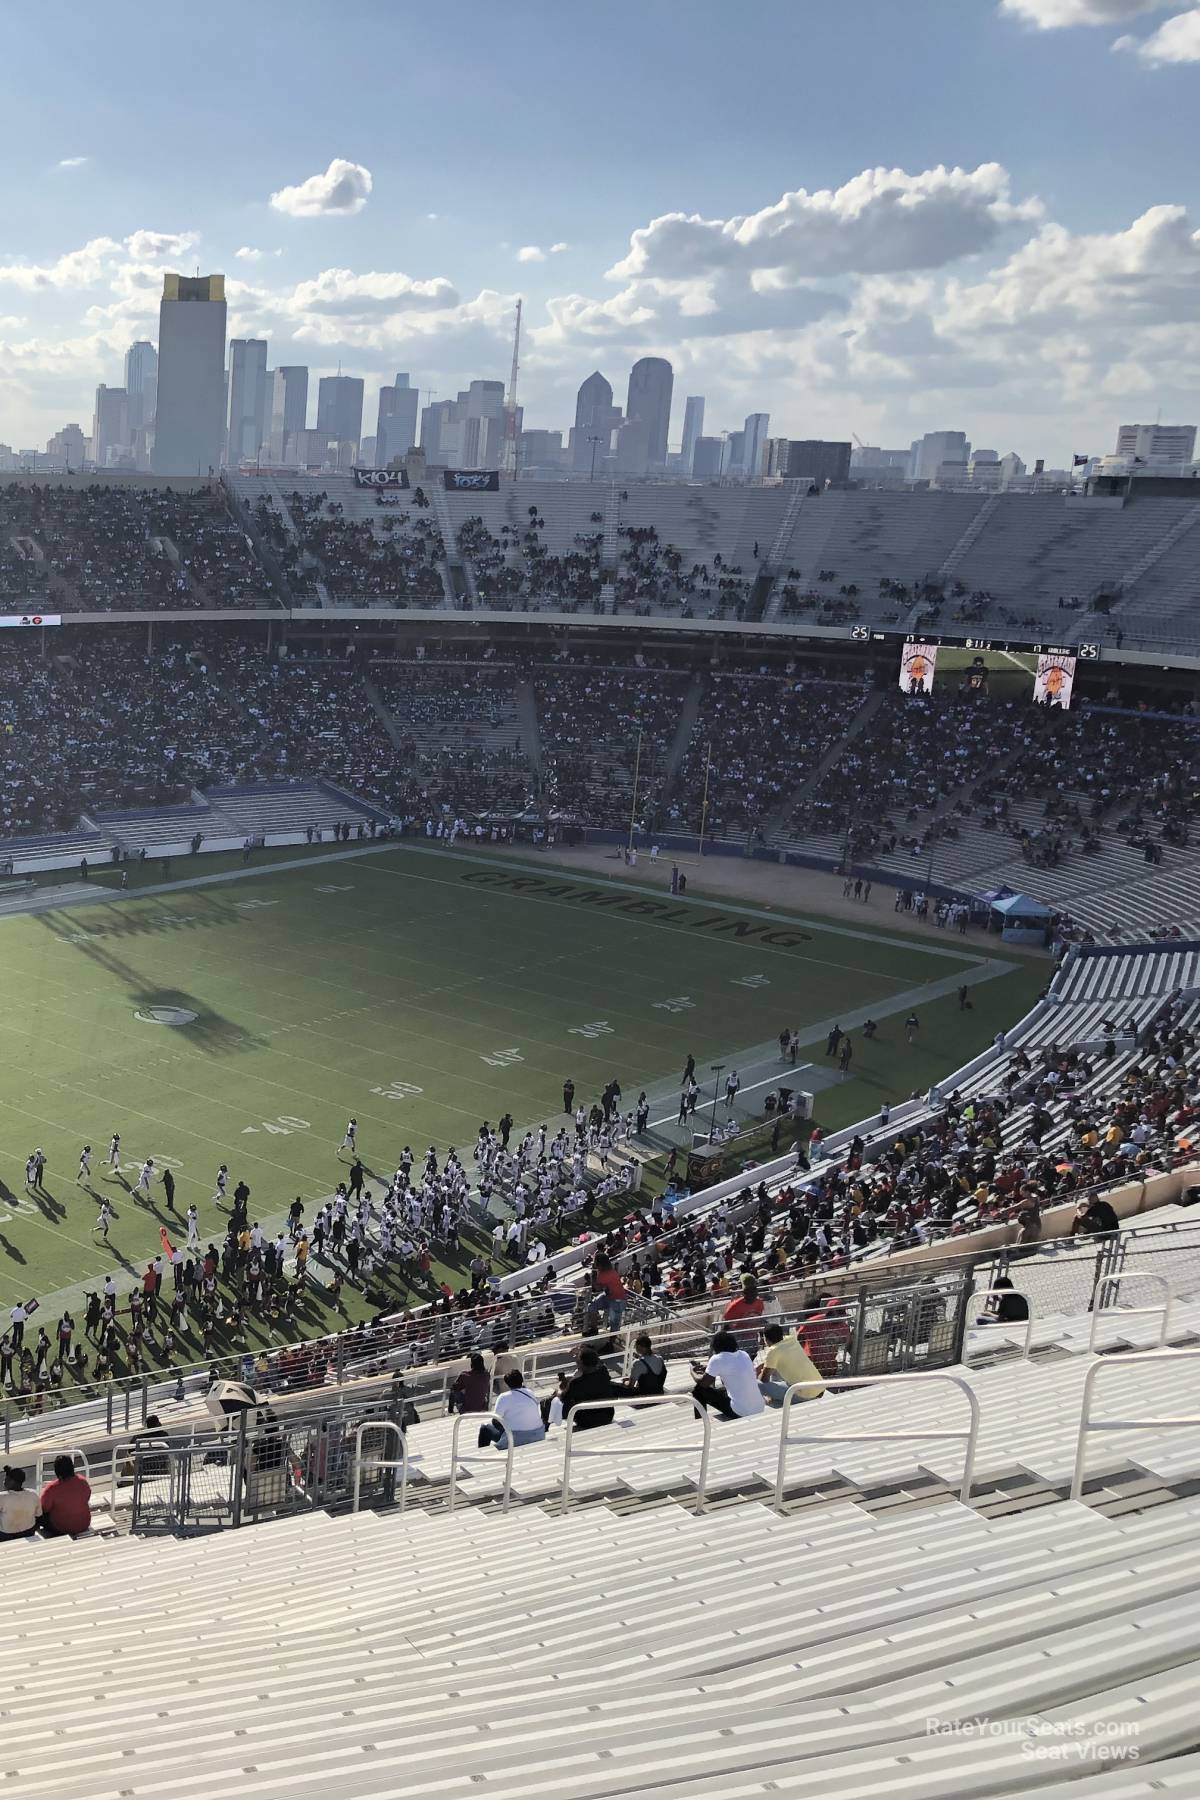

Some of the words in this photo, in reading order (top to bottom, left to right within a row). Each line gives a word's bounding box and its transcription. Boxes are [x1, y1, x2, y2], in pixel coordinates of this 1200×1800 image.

[358, 471, 403, 486] K104
[851, 627, 868, 639] 25
[1080, 645, 1097, 658] 25
[460, 872, 813, 948] GRAMBLING
[480, 1048, 525, 1067] 40
[369, 1081, 424, 1100] 50
[262, 1115, 311, 1135] 40
